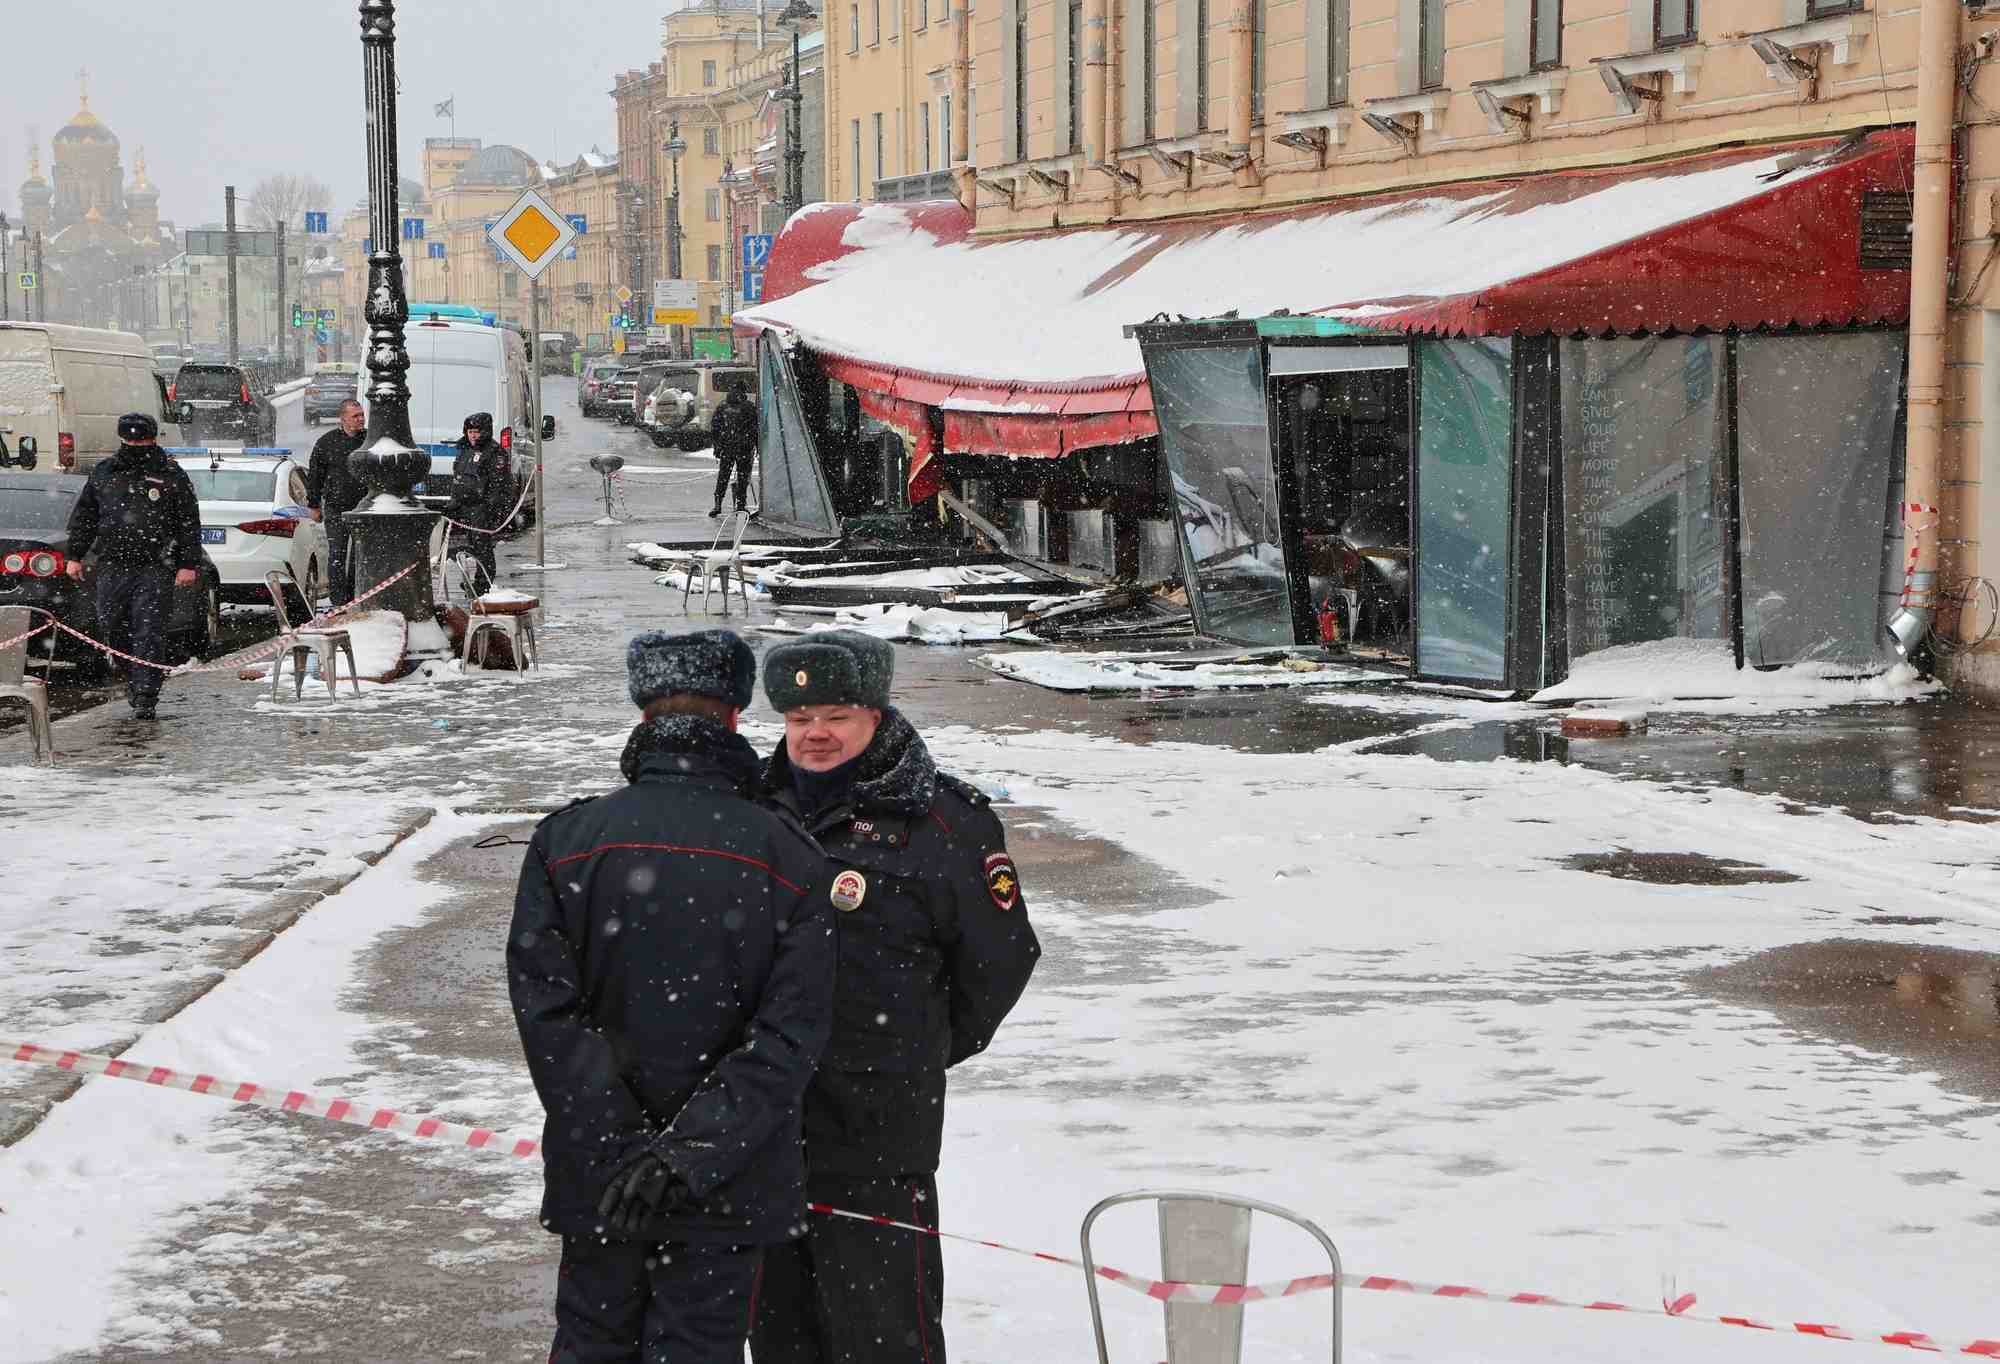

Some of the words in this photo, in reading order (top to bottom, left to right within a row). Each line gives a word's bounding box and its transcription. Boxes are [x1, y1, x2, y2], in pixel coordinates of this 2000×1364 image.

[1583, 423, 1617, 435] YOUR
[1582, 458, 1619, 472] MORE
[1583, 512, 1615, 523] GIVE
[1584, 545, 1615, 559] TIME
[1584, 562, 1613, 576] YOU
[1584, 580, 1618, 593] HAVE
[1585, 598, 1617, 611] LEFT
